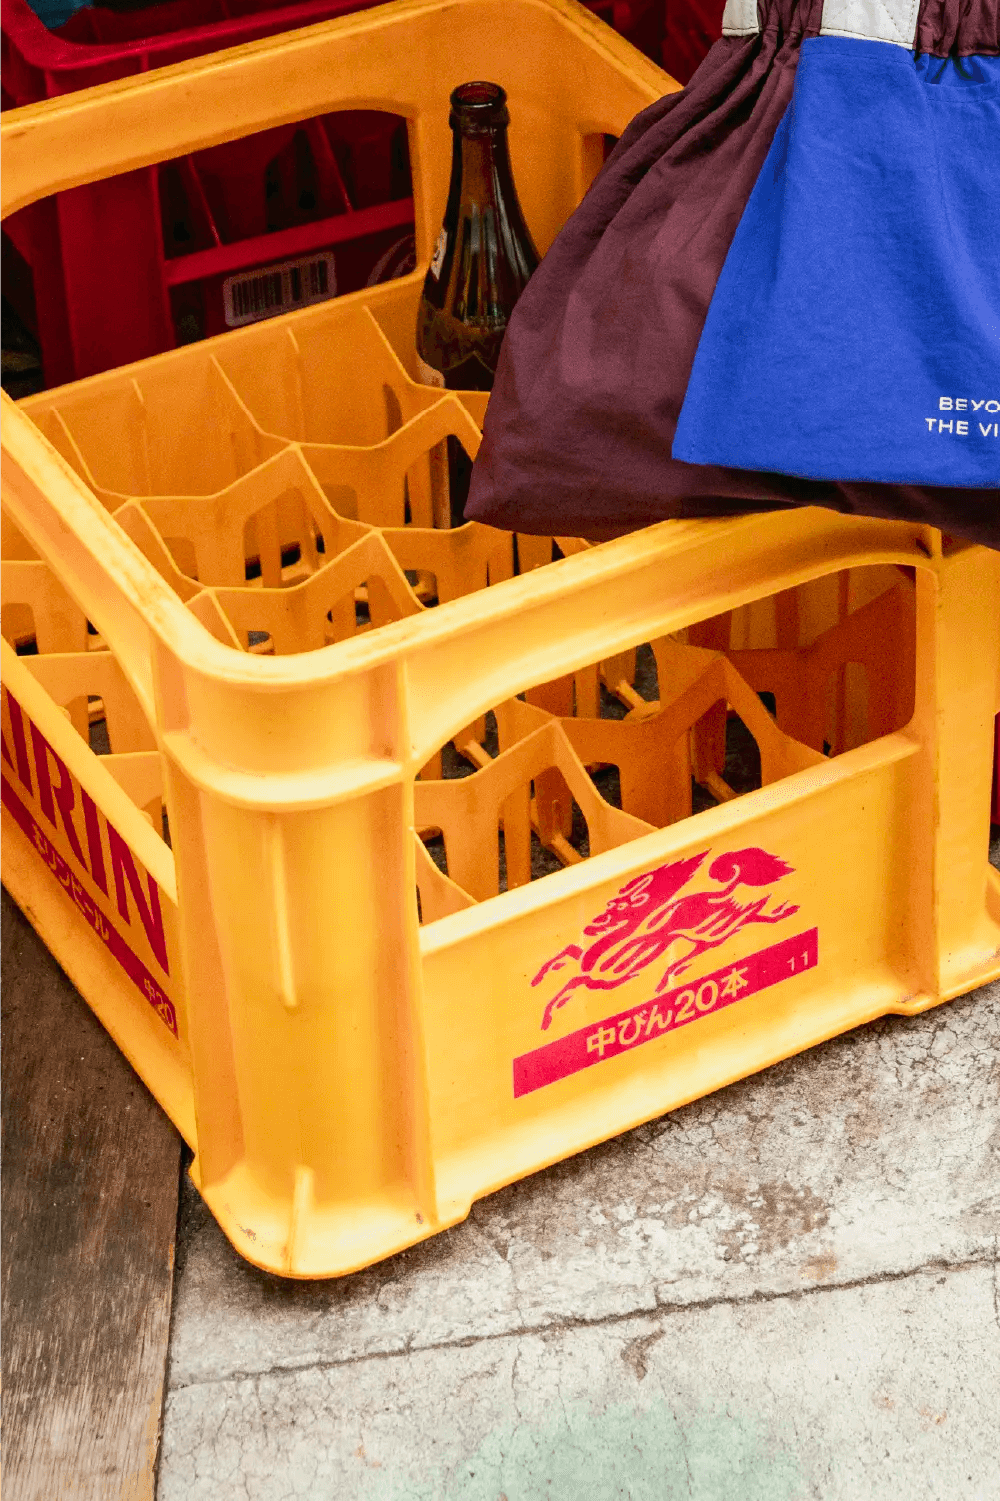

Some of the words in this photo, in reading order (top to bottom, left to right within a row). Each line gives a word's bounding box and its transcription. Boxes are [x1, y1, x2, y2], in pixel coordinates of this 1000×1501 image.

[925, 417, 969, 436] THE
[0, 687, 171, 978] IRIN
[586, 967, 750, 1057] 中びん20本
